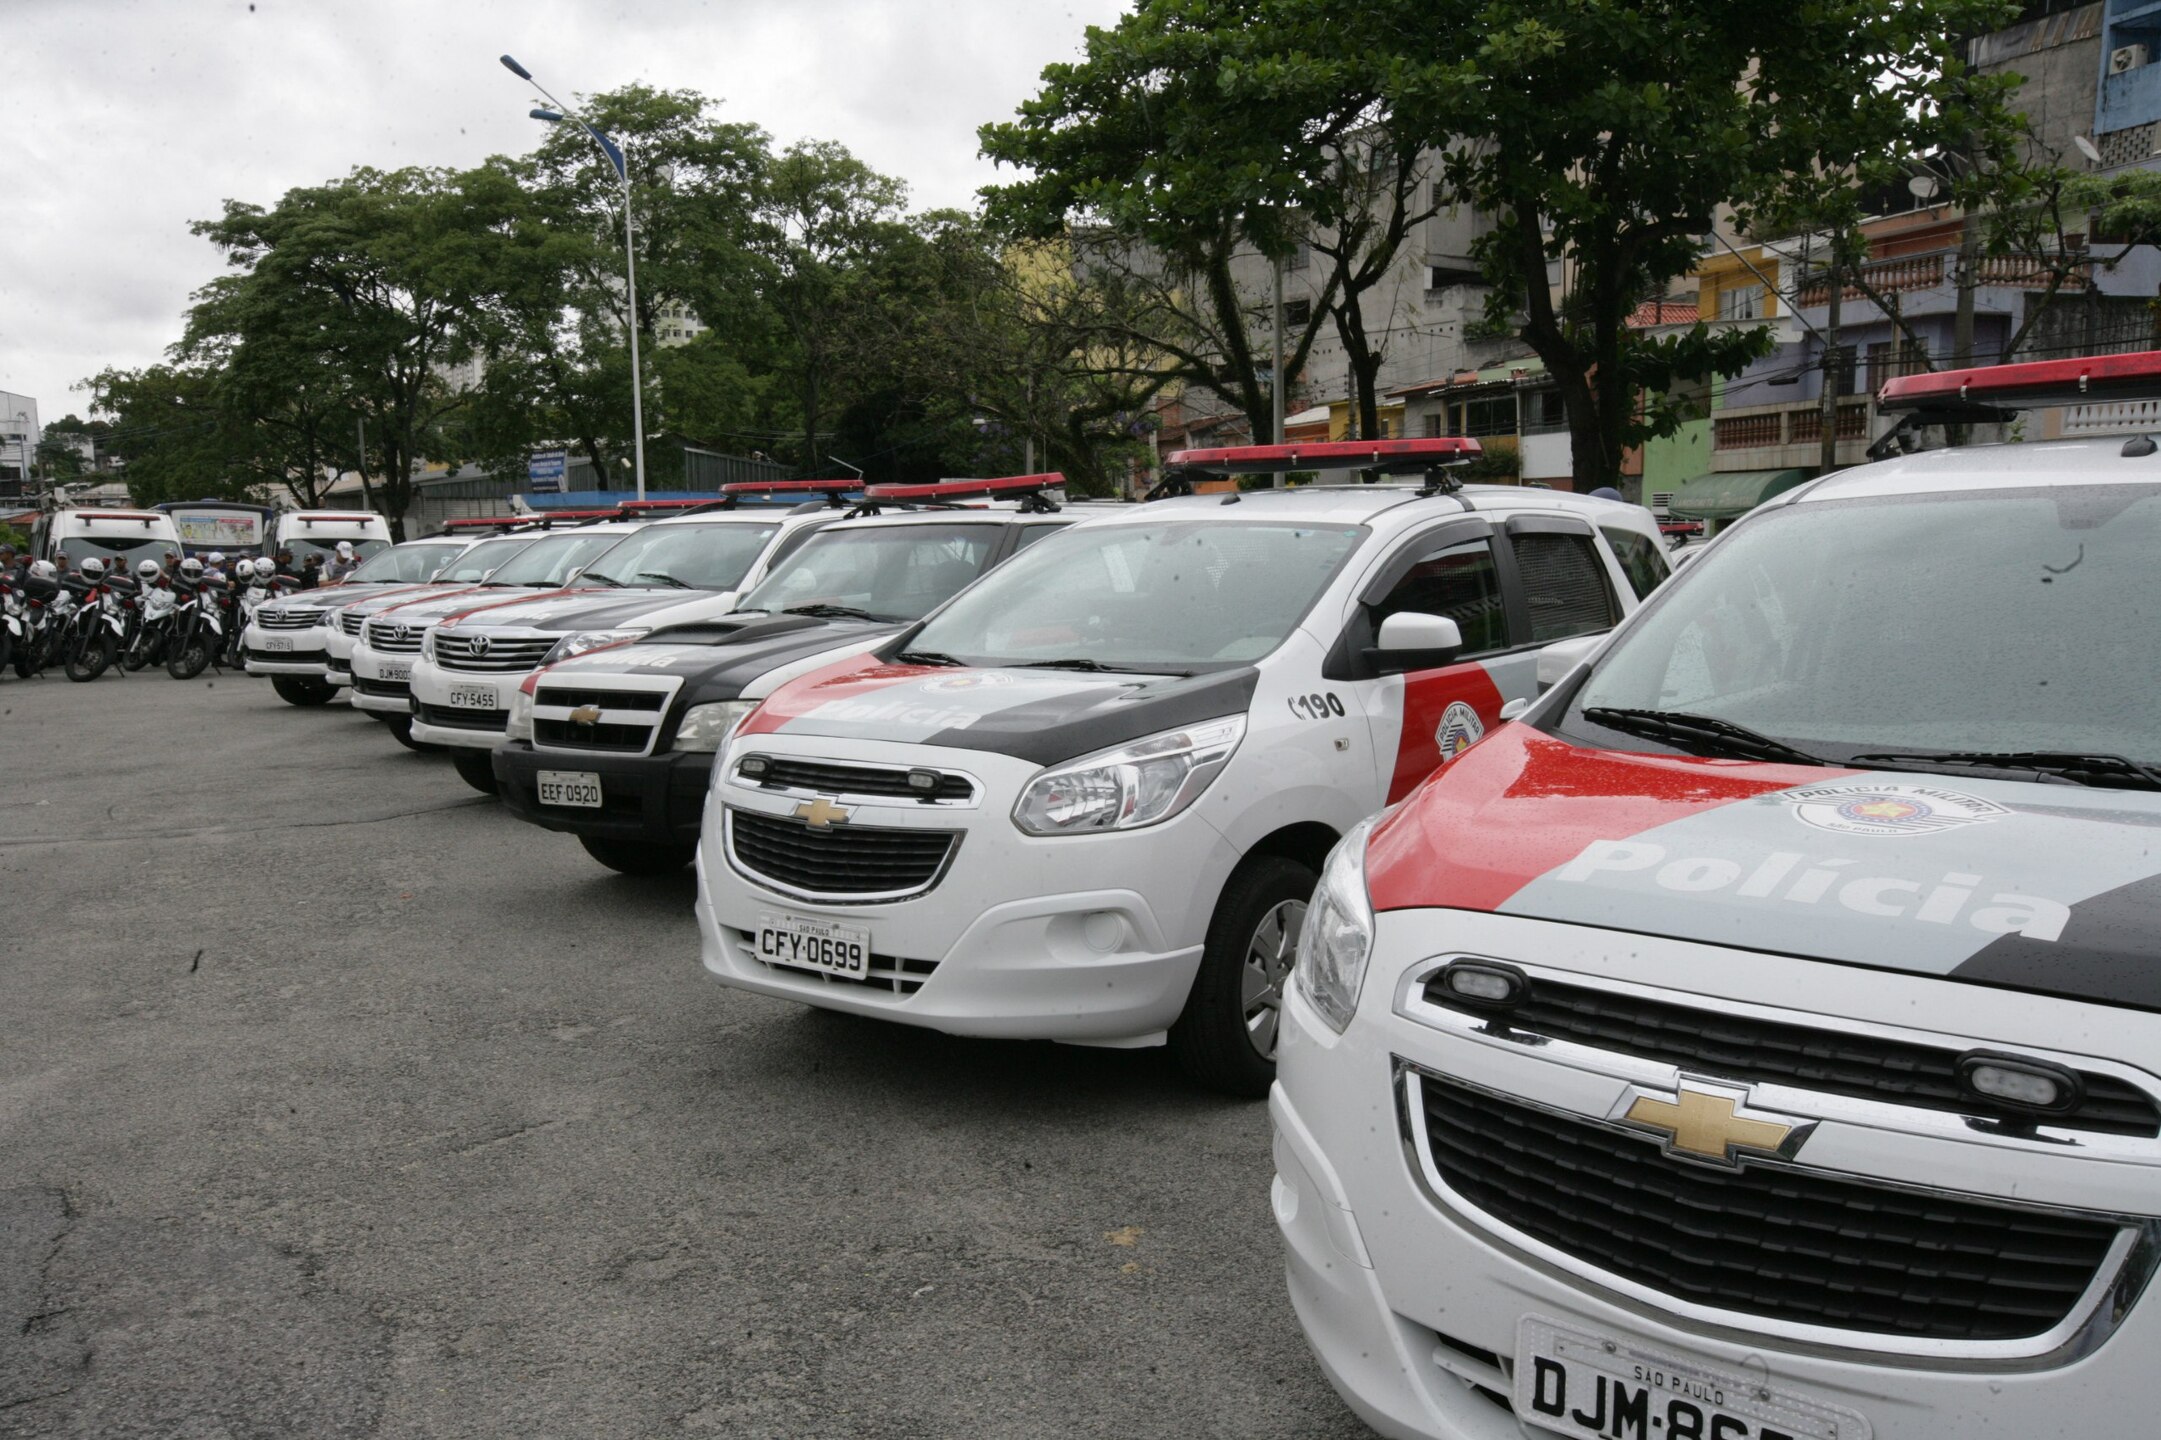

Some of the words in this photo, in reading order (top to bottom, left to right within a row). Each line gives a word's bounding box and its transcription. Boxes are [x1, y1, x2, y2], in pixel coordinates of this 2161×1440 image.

[1297, 691, 1346, 720] 190
[1912, 788, 1994, 815] MILITAR
[1556, 839, 2071, 942] Polícia
[1672, 1376, 1724, 1405] PAULO
